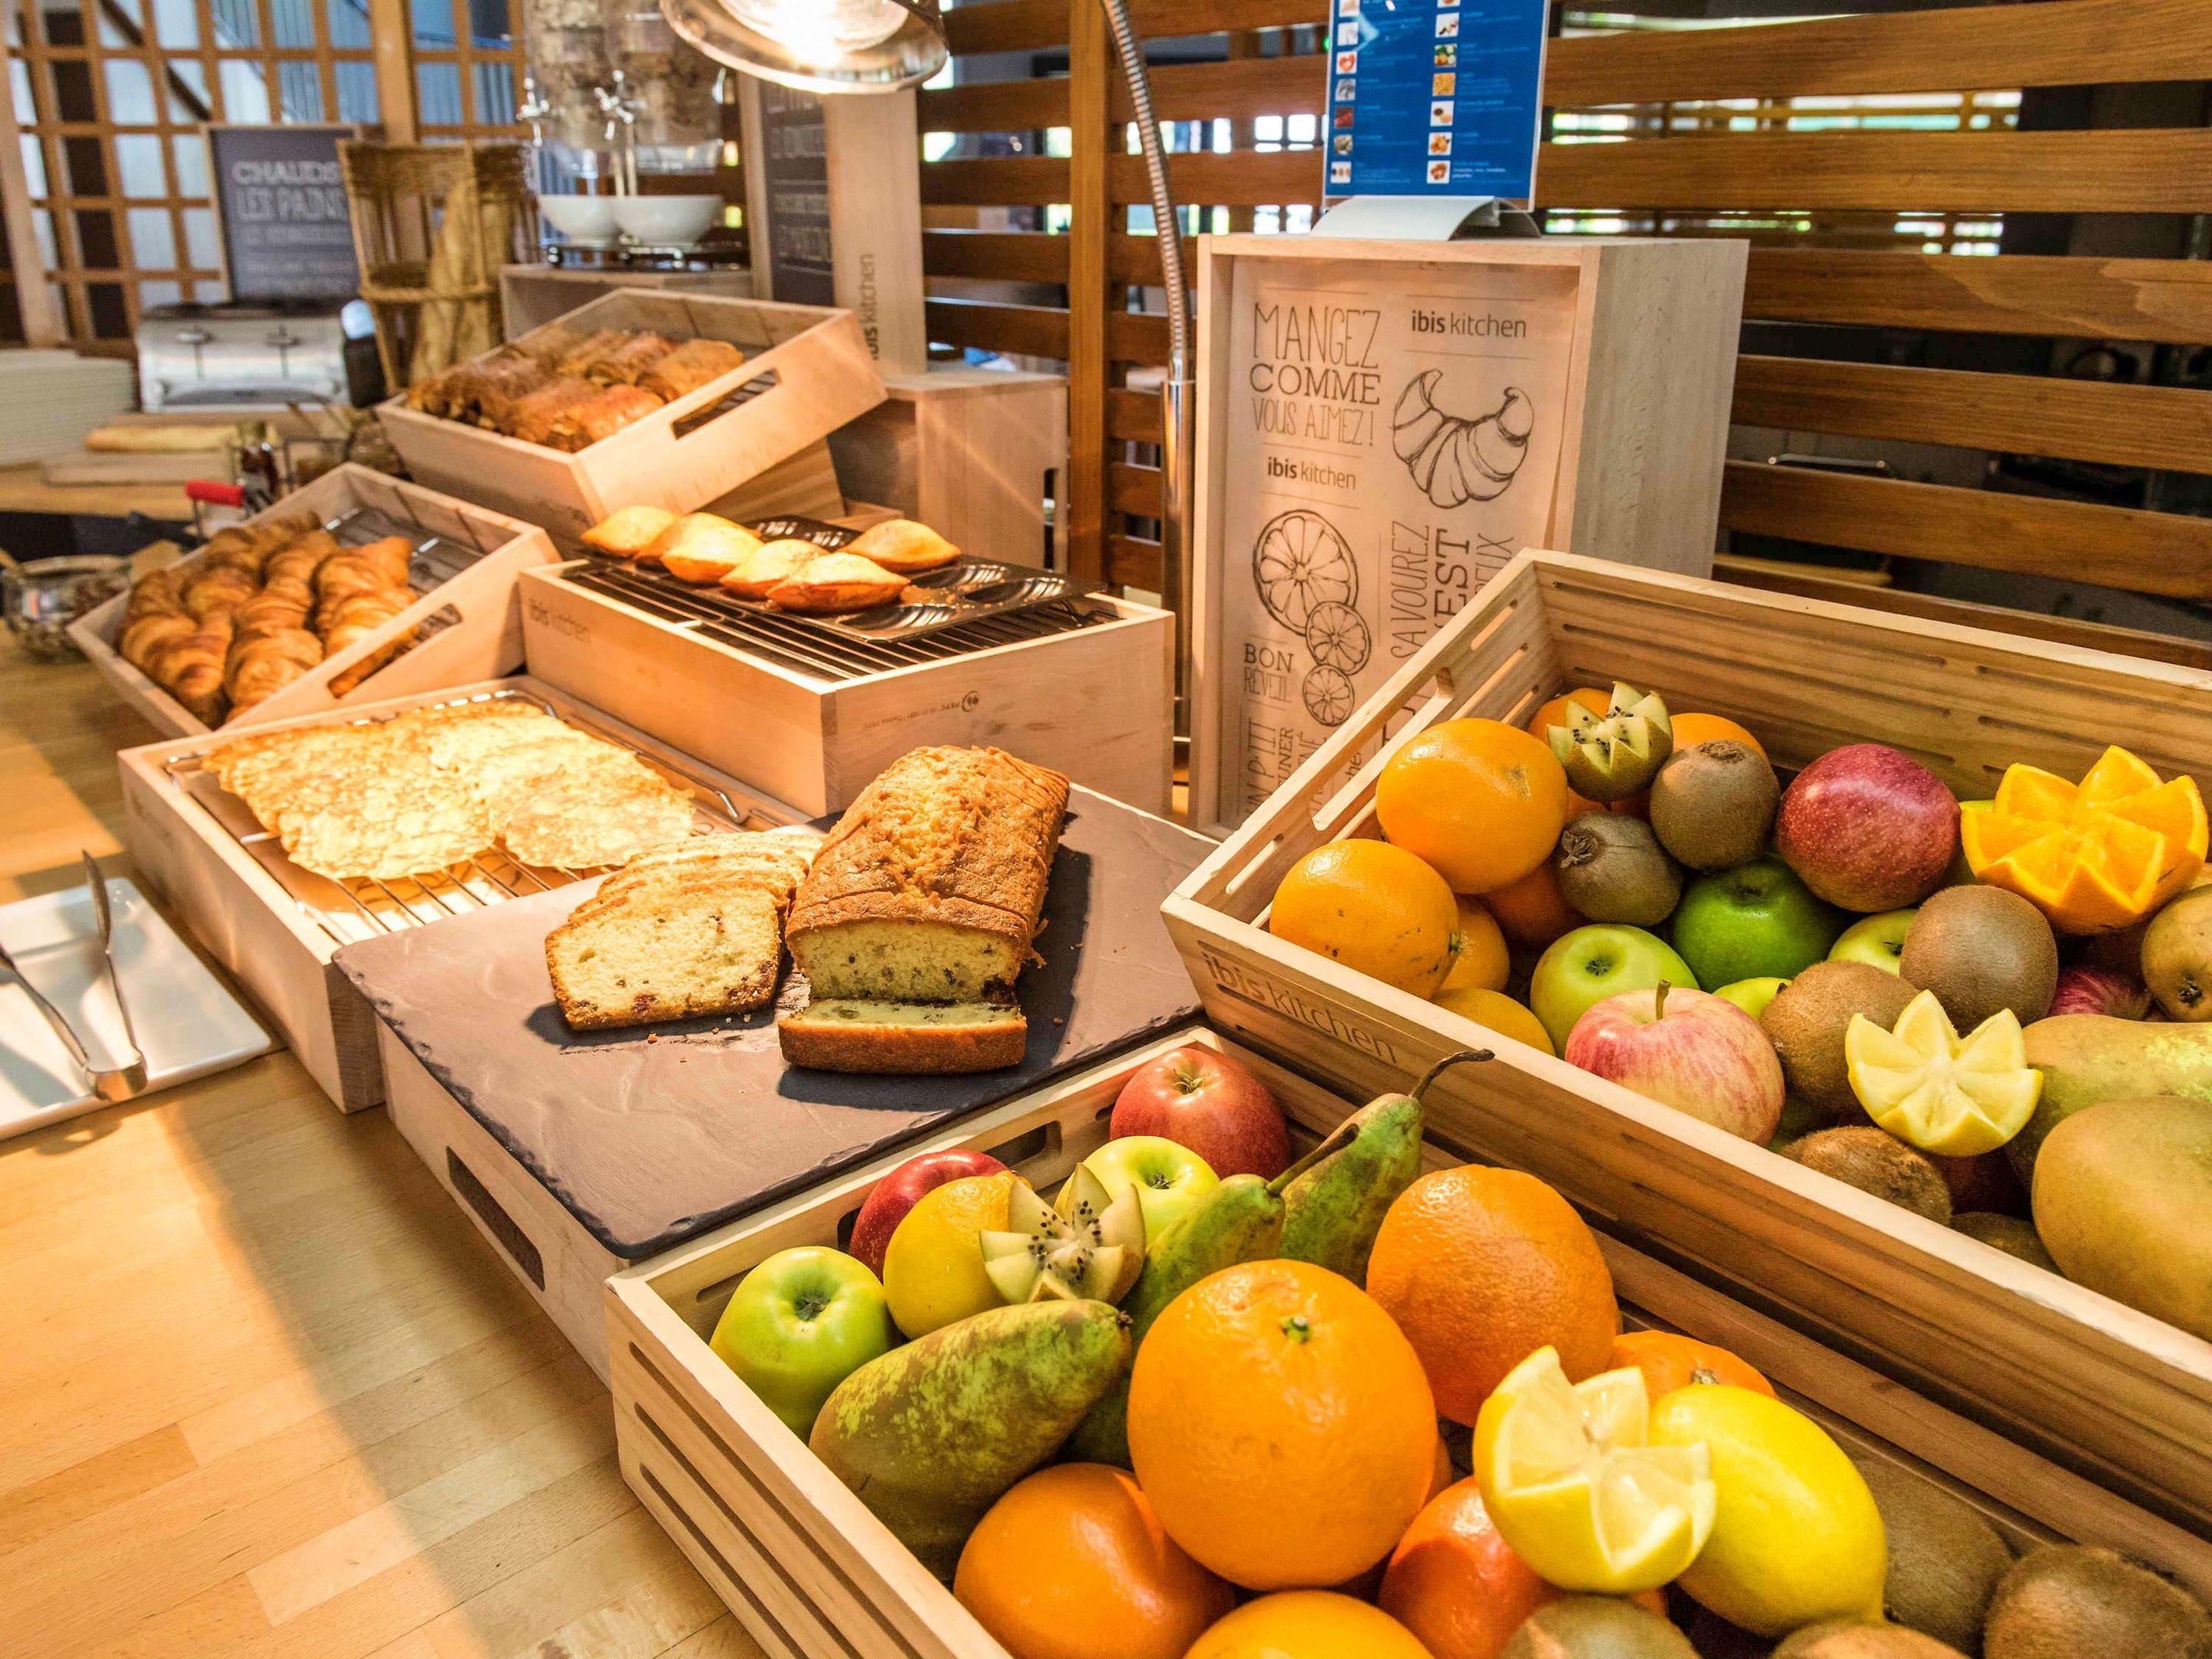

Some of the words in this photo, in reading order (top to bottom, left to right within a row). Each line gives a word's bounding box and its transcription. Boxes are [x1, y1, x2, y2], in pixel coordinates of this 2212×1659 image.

[1253, 303, 1381, 369] MANGEZ
[1412, 310, 1445, 333] ibis
[1450, 313, 1527, 337] kitchen
[863, 326, 879, 361] bis
[1250, 363, 1381, 405] COMME
[1252, 398, 1297, 435] VOUS
[1267, 456, 1297, 478] ibis
[1300, 461, 1356, 490] kitchen
[1391, 521, 1429, 658] SAVOUREZ
[1244, 643, 1294, 673] BON
[1278, 727, 1293, 787] UNER
[1202, 952, 1266, 1001] ibis
[1267, 981, 1397, 1064] kitchen
